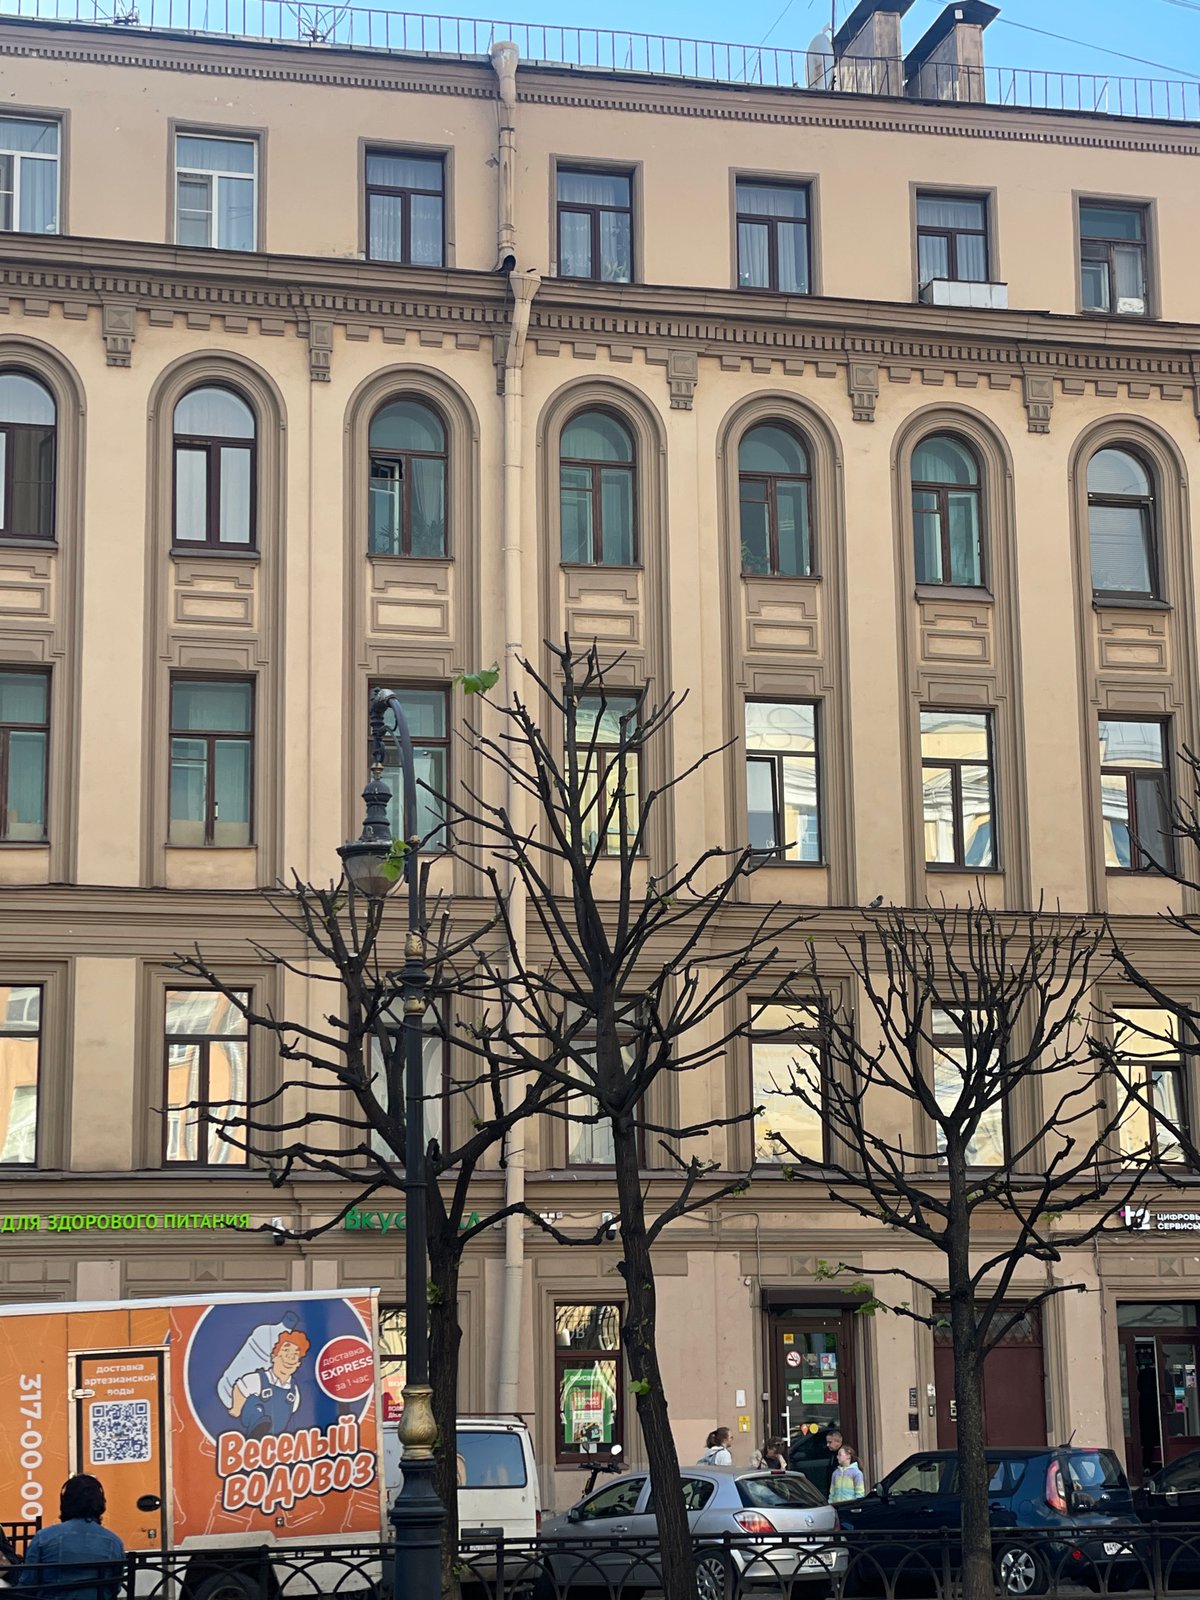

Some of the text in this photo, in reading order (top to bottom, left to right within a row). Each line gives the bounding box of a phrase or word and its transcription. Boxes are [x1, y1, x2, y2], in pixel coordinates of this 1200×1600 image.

[1, 1213, 250, 1233] ДЛЯ ЗДОРОВОГО ПИТАНИЯ
[322, 1347, 365, 1367] доставка
[96, 1363, 144, 1374] доставка
[321, 1355, 373, 1381] EXPRESS
[84, 1373, 157, 1386] артезианской
[334, 1382, 347, 1391] за
[352, 1374, 370, 1385] час
[19, 1374, 43, 1521] 317-00-00
[218, 1414, 358, 1476] Веселый
